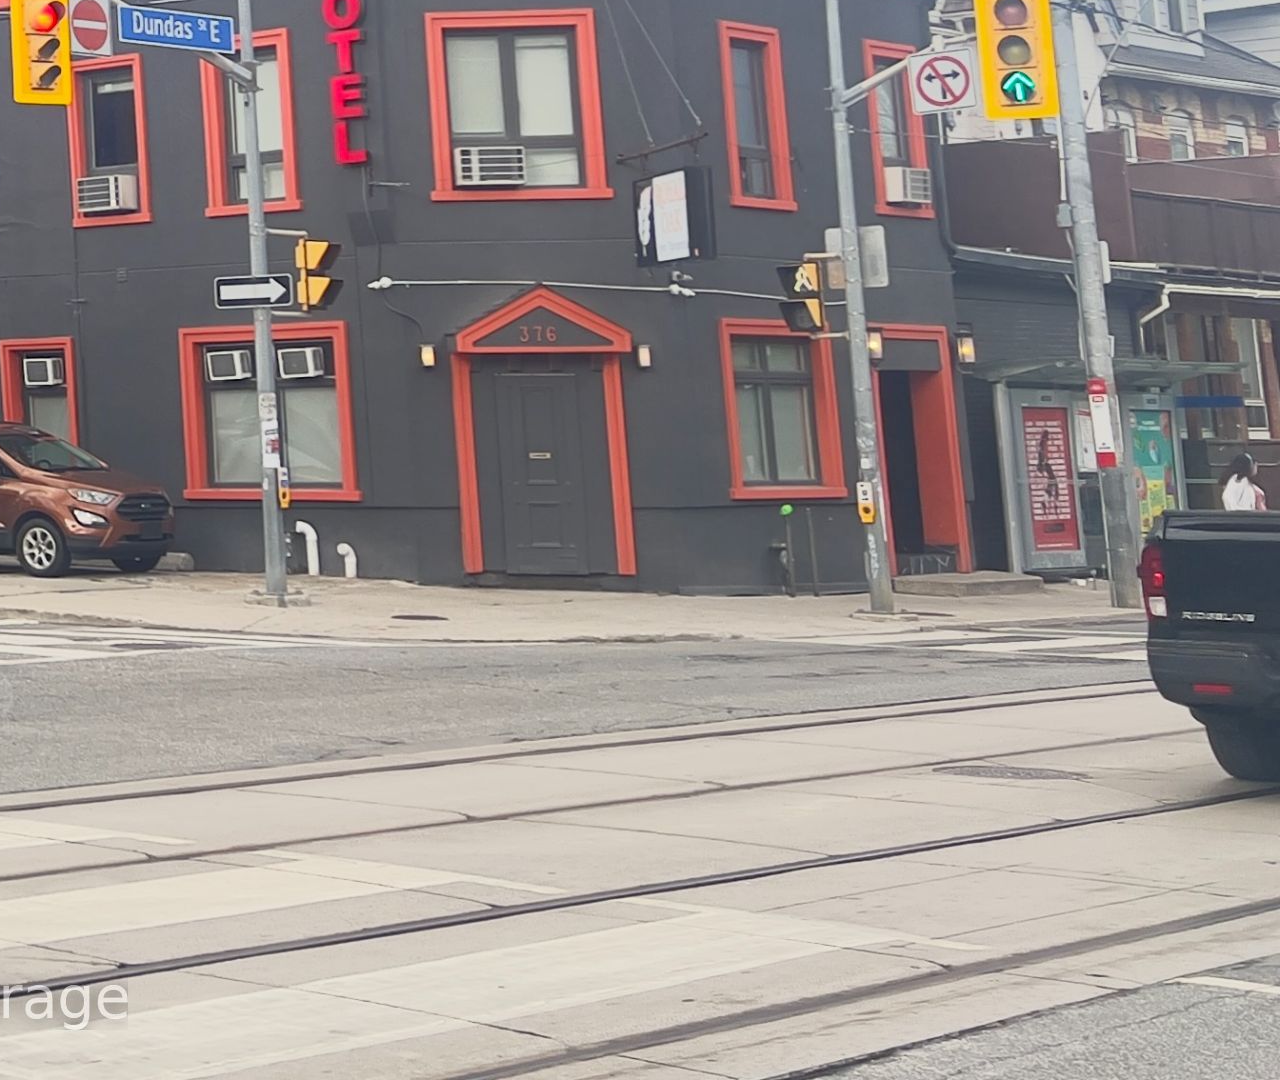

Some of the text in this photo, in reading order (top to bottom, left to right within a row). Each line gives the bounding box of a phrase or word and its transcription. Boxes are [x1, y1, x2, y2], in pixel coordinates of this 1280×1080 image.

[132, 11, 193, 39] Dundas
[210, 20, 220, 43] E
[519, 326, 557, 342] 376
